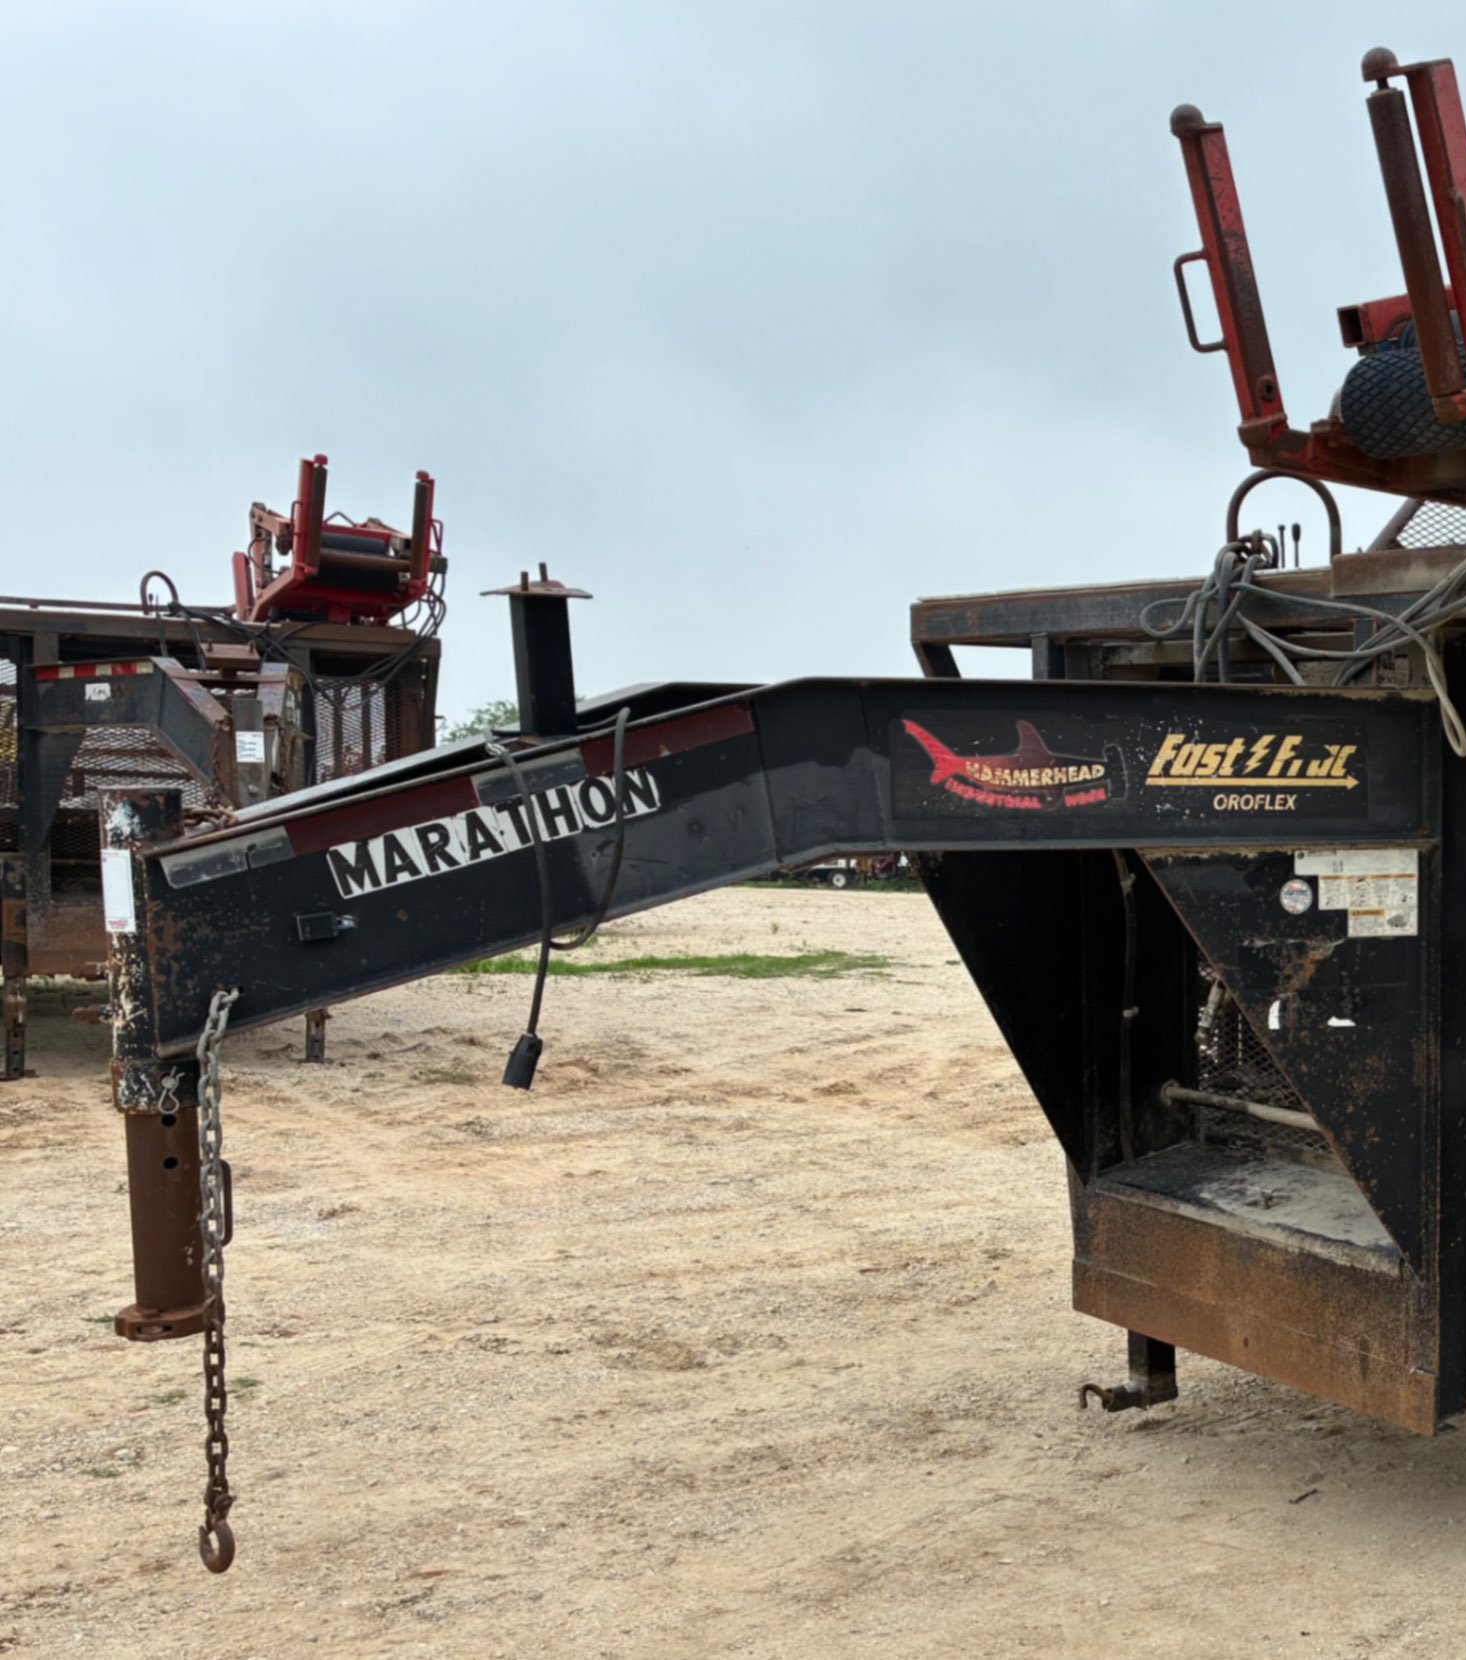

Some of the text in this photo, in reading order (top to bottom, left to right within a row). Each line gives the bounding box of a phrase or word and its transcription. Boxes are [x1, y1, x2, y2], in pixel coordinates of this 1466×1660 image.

[1147, 733, 1246, 777] Fast
[965, 760, 1106, 787] HAMMERHEAD
[1213, 793, 1298, 811] OROFLEX
[326, 766, 657, 896] MARATHON
